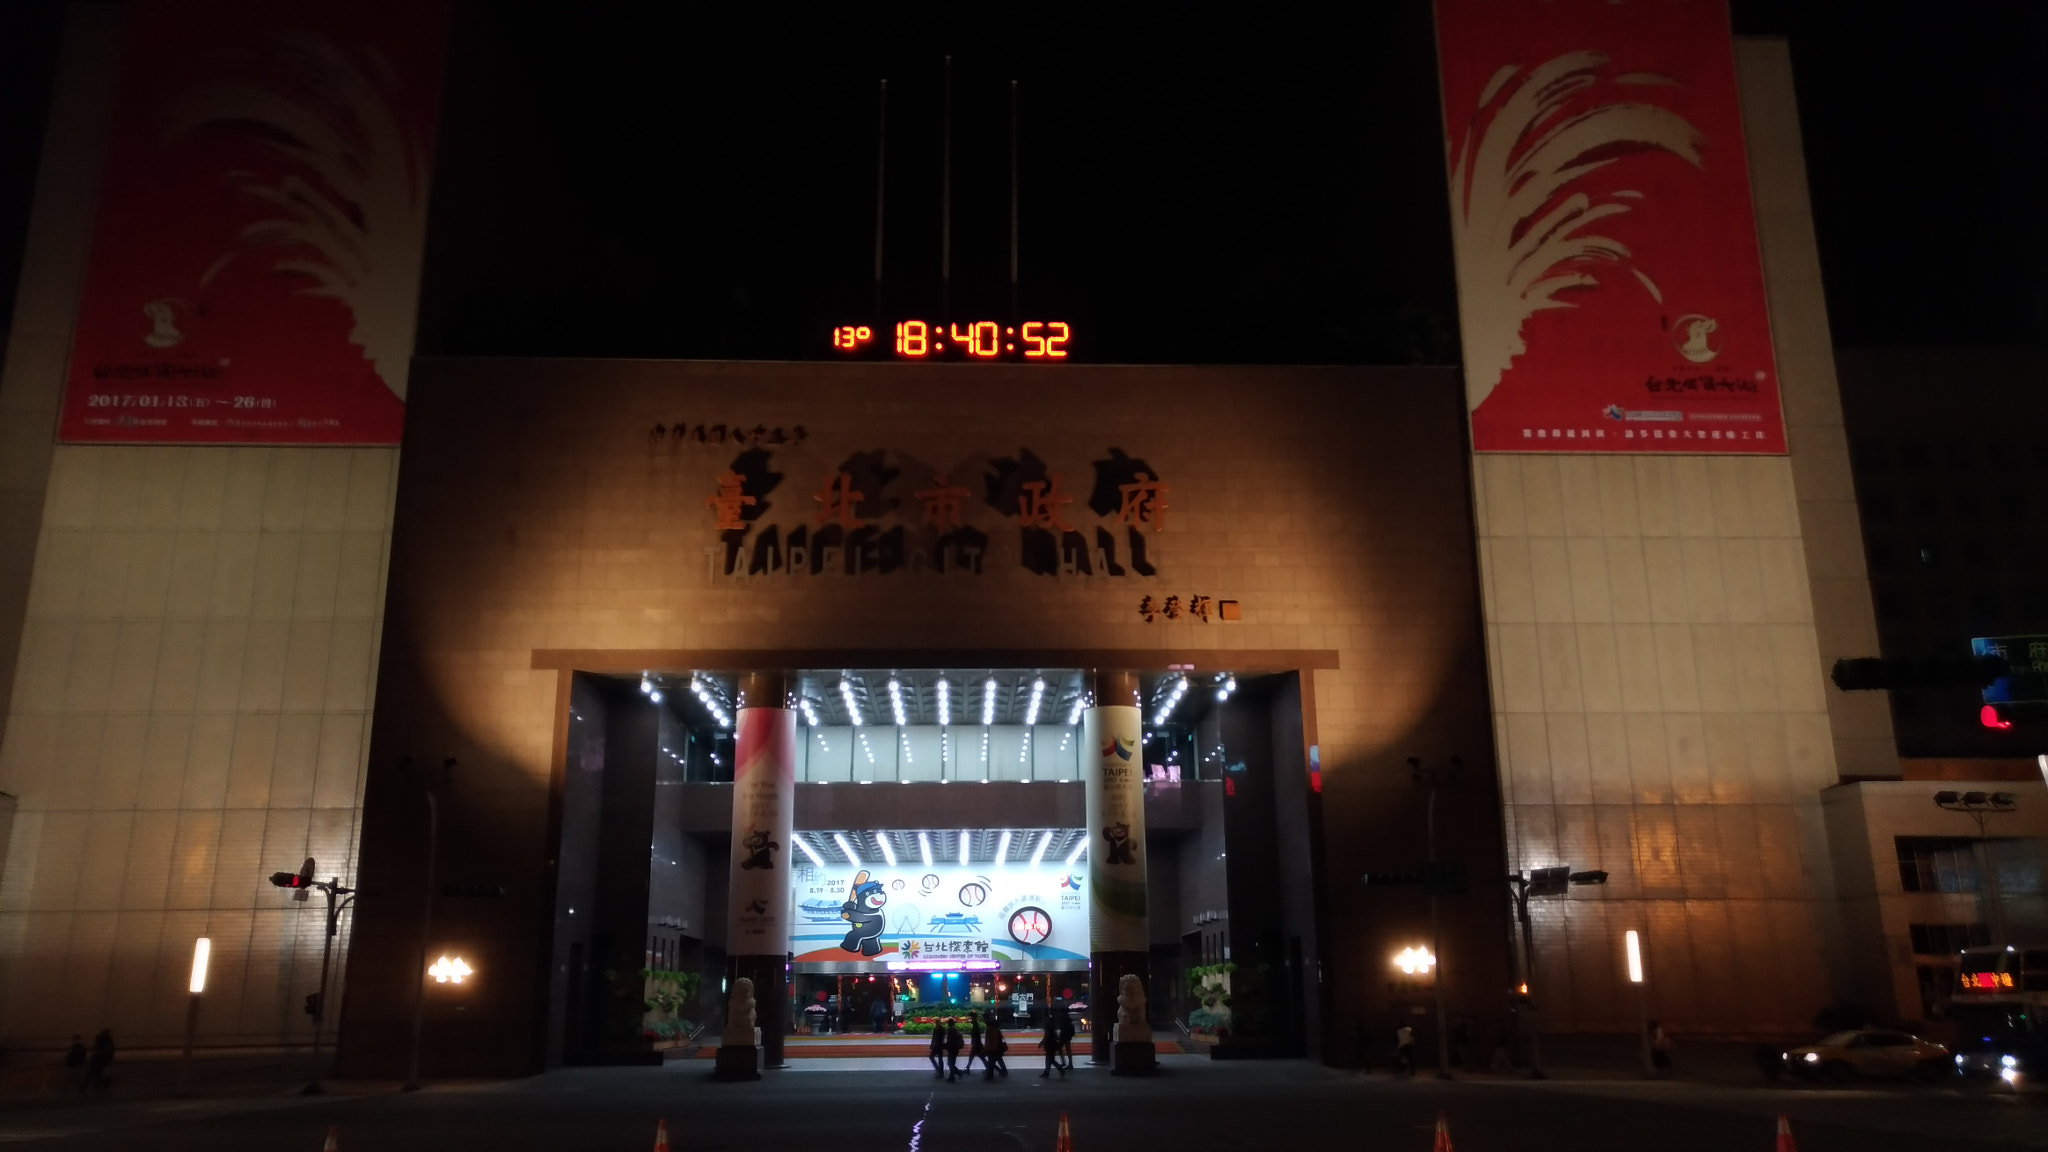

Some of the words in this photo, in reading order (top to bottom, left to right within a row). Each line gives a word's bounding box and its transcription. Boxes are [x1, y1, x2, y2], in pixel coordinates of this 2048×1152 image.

[895, 319, 1070, 357] 18:40:52
[705, 472, 1171, 533] 臺北市政府
[703, 545, 863, 585] TAIPEI
[1103, 768, 1133, 777] TAIPEI
[923, 940, 989, 953] 台北探索館
[1011, 992, 1034, 1001] 西大門
